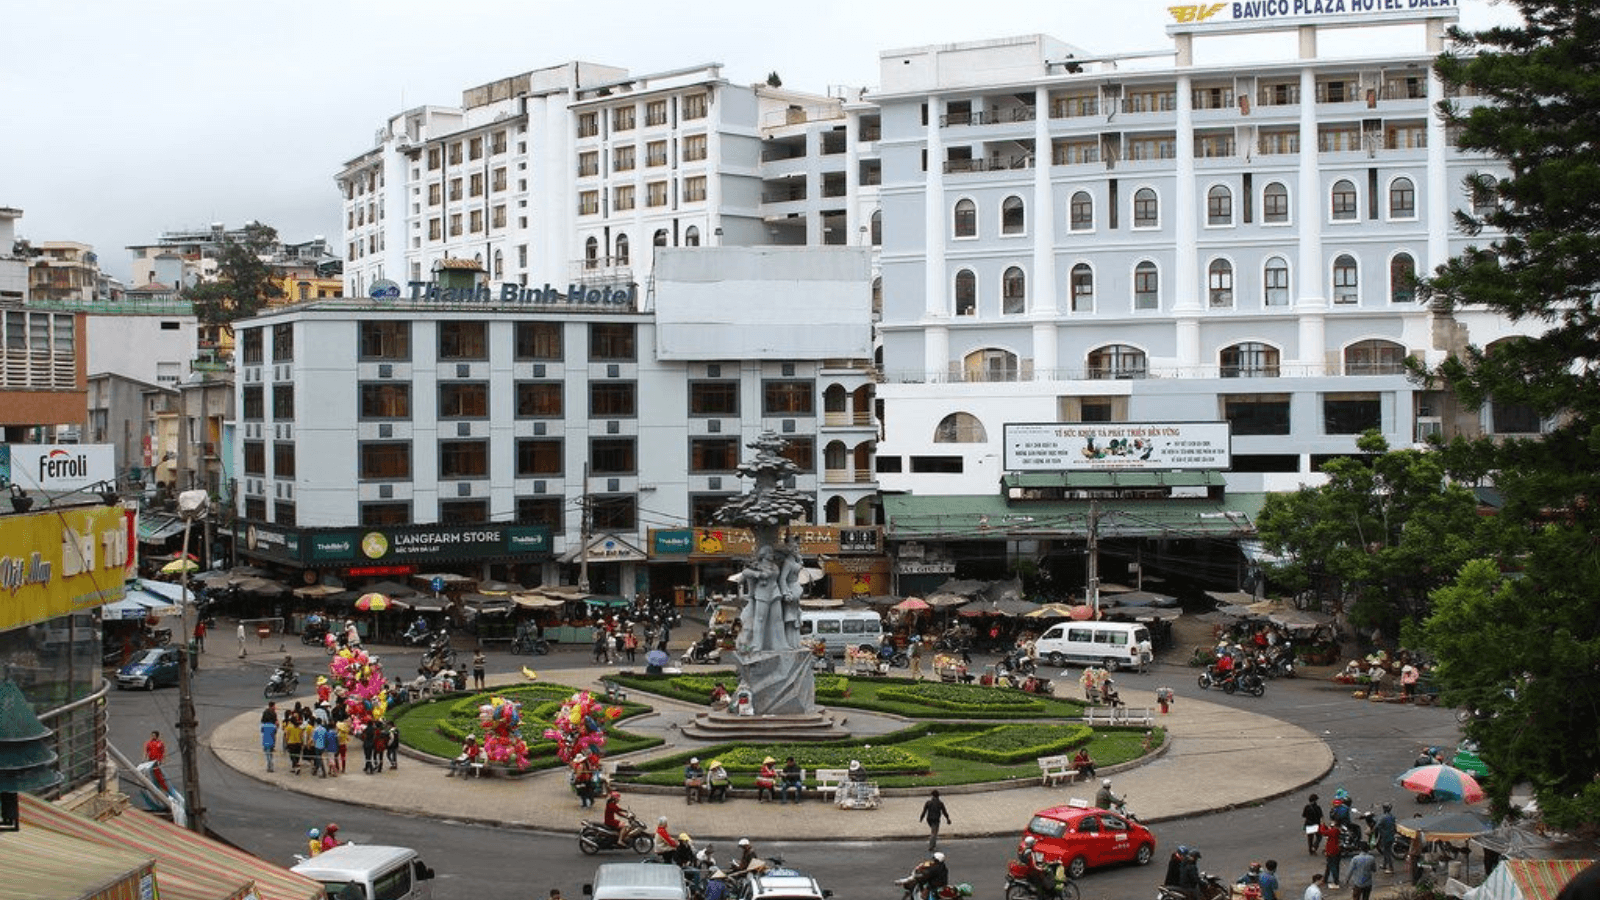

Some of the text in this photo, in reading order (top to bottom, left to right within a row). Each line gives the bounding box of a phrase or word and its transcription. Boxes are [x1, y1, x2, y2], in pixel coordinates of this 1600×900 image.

[1233, 0, 1288, 19] BAVICO
[1294, 0, 1346, 15] PLAZA
[1352, 0, 1403, 12] HOTEL
[408, 282, 492, 303] Thanh
[567, 284, 632, 306] Hotel
[40, 455, 87, 482] Ferroli
[395, 533, 460, 545] L'ANGFARM
[463, 531, 500, 543] STORE
